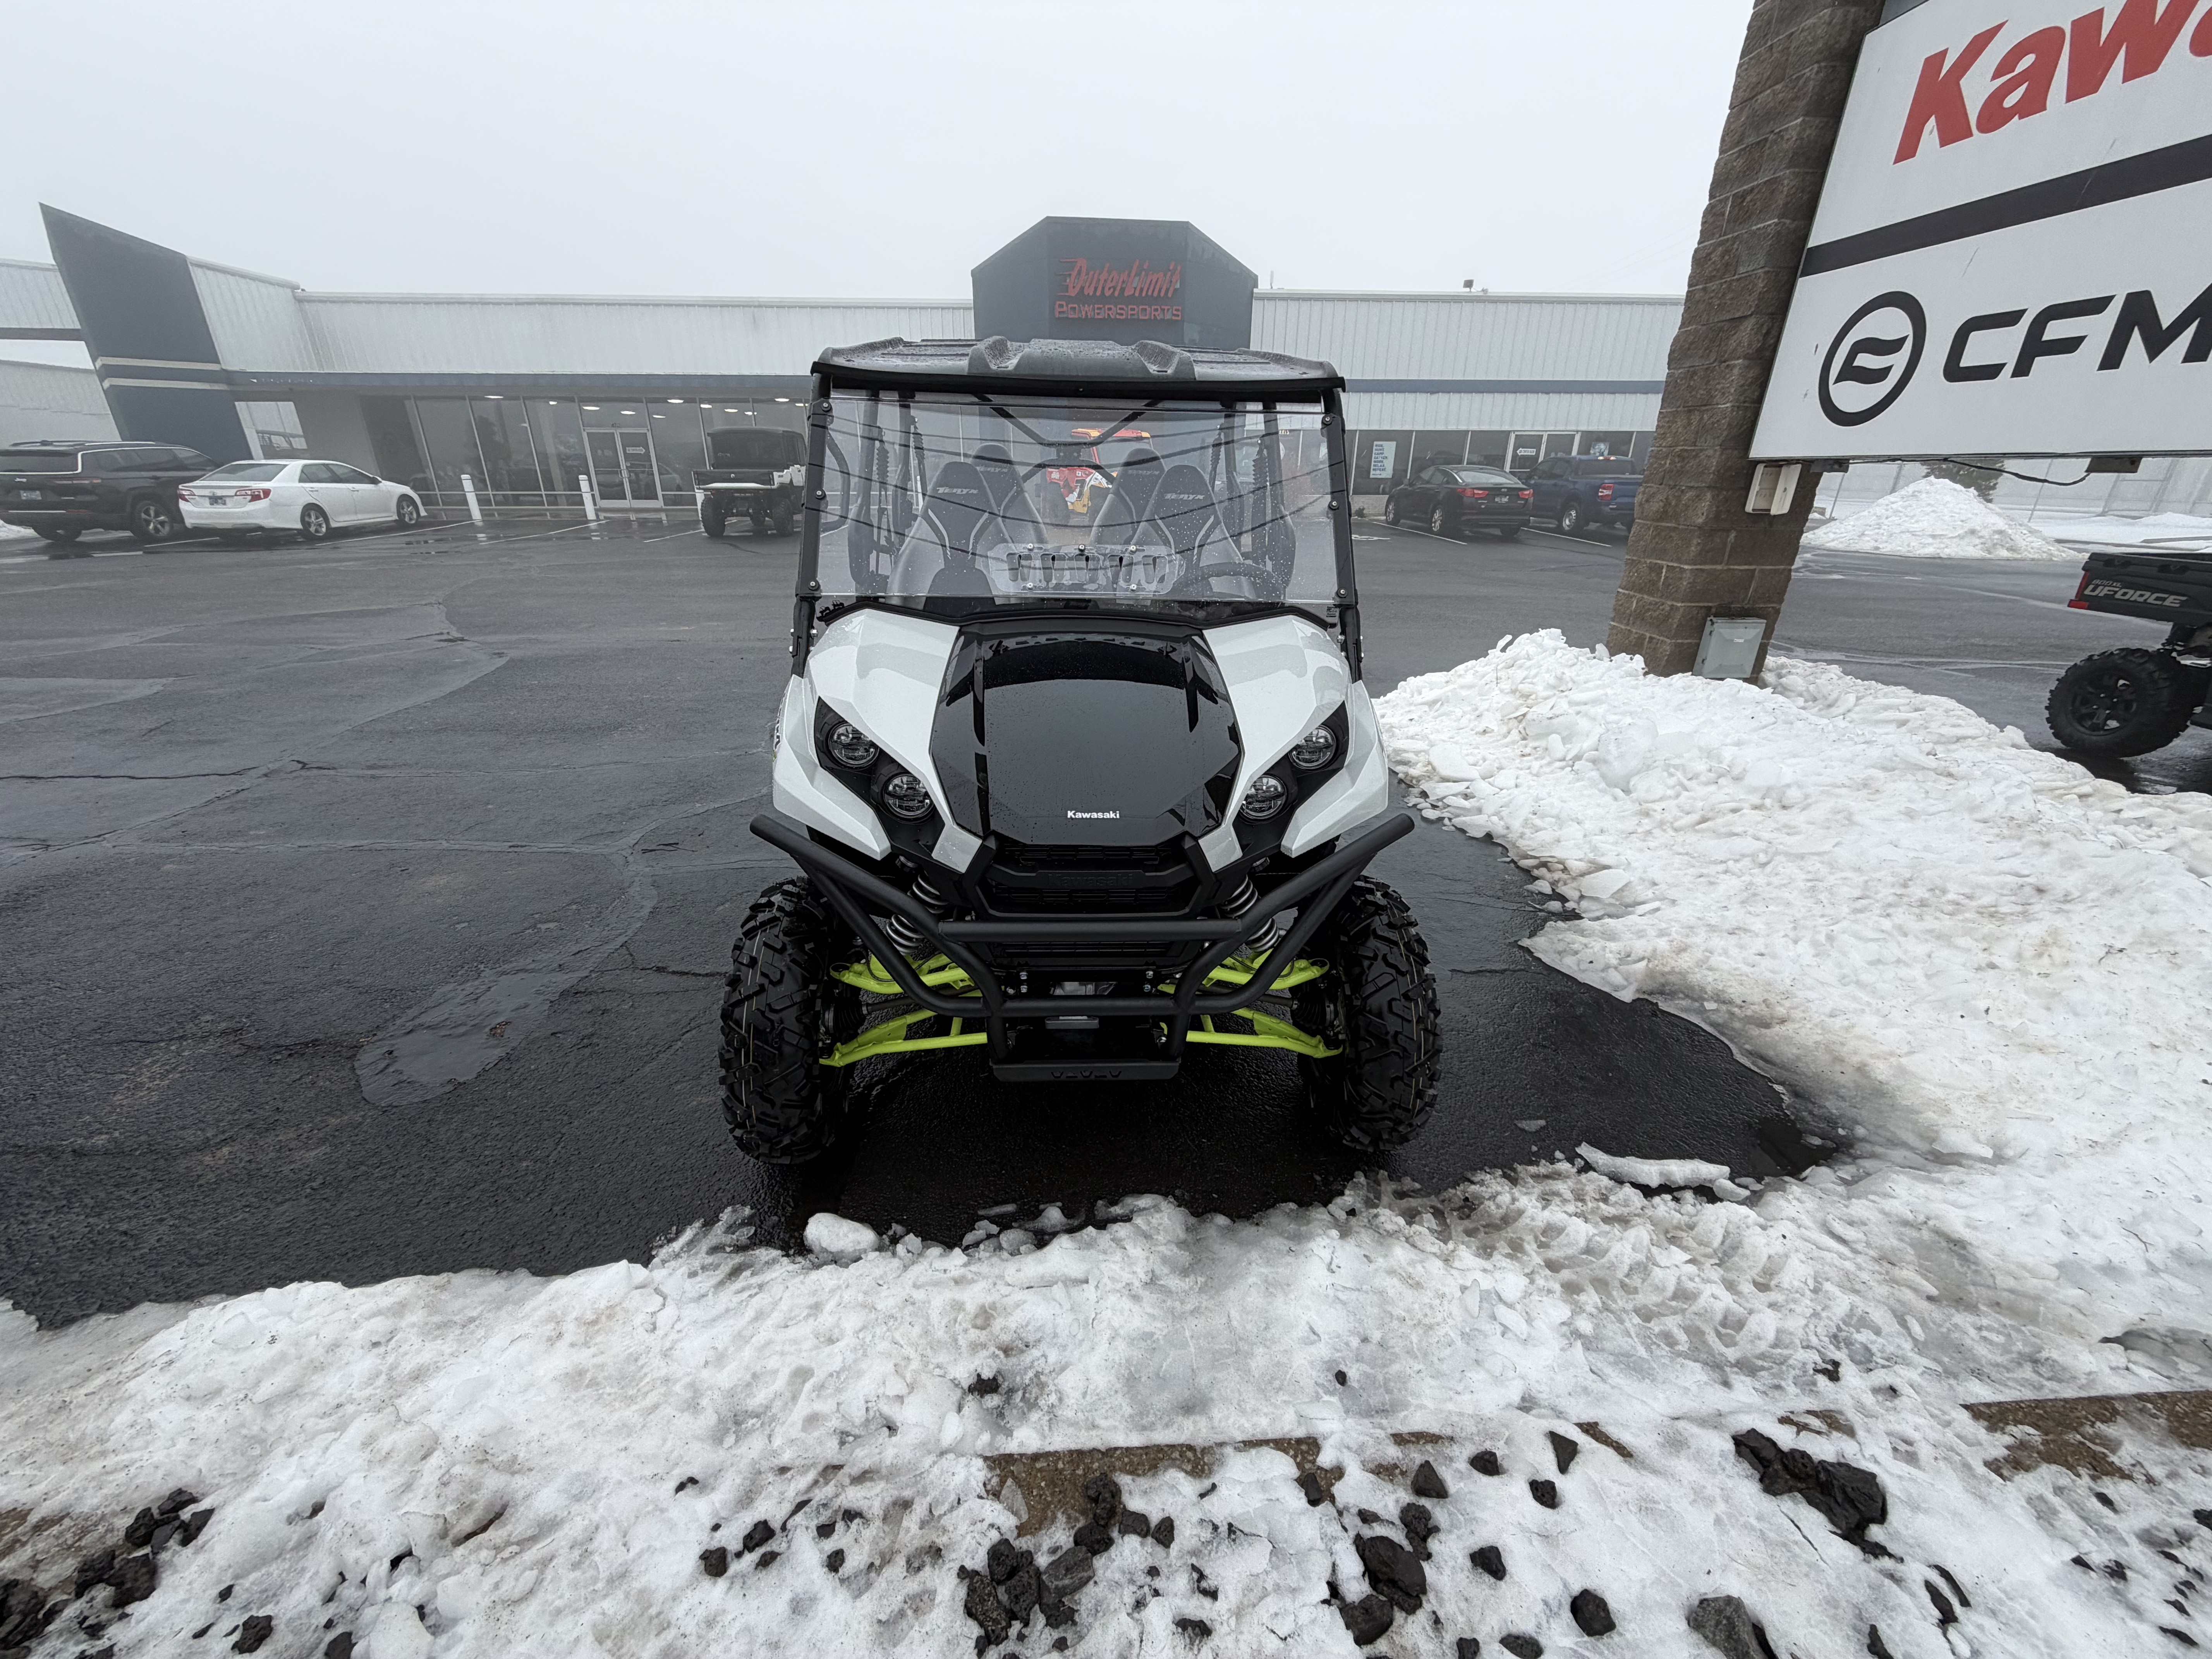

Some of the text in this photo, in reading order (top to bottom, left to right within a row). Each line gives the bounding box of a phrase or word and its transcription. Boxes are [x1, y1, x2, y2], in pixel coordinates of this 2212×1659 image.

[1893, 0, 2212, 165] Kaw
[2083, 584, 2188, 607] UFORCE
[1067, 811, 1120, 819] Kawasaki
